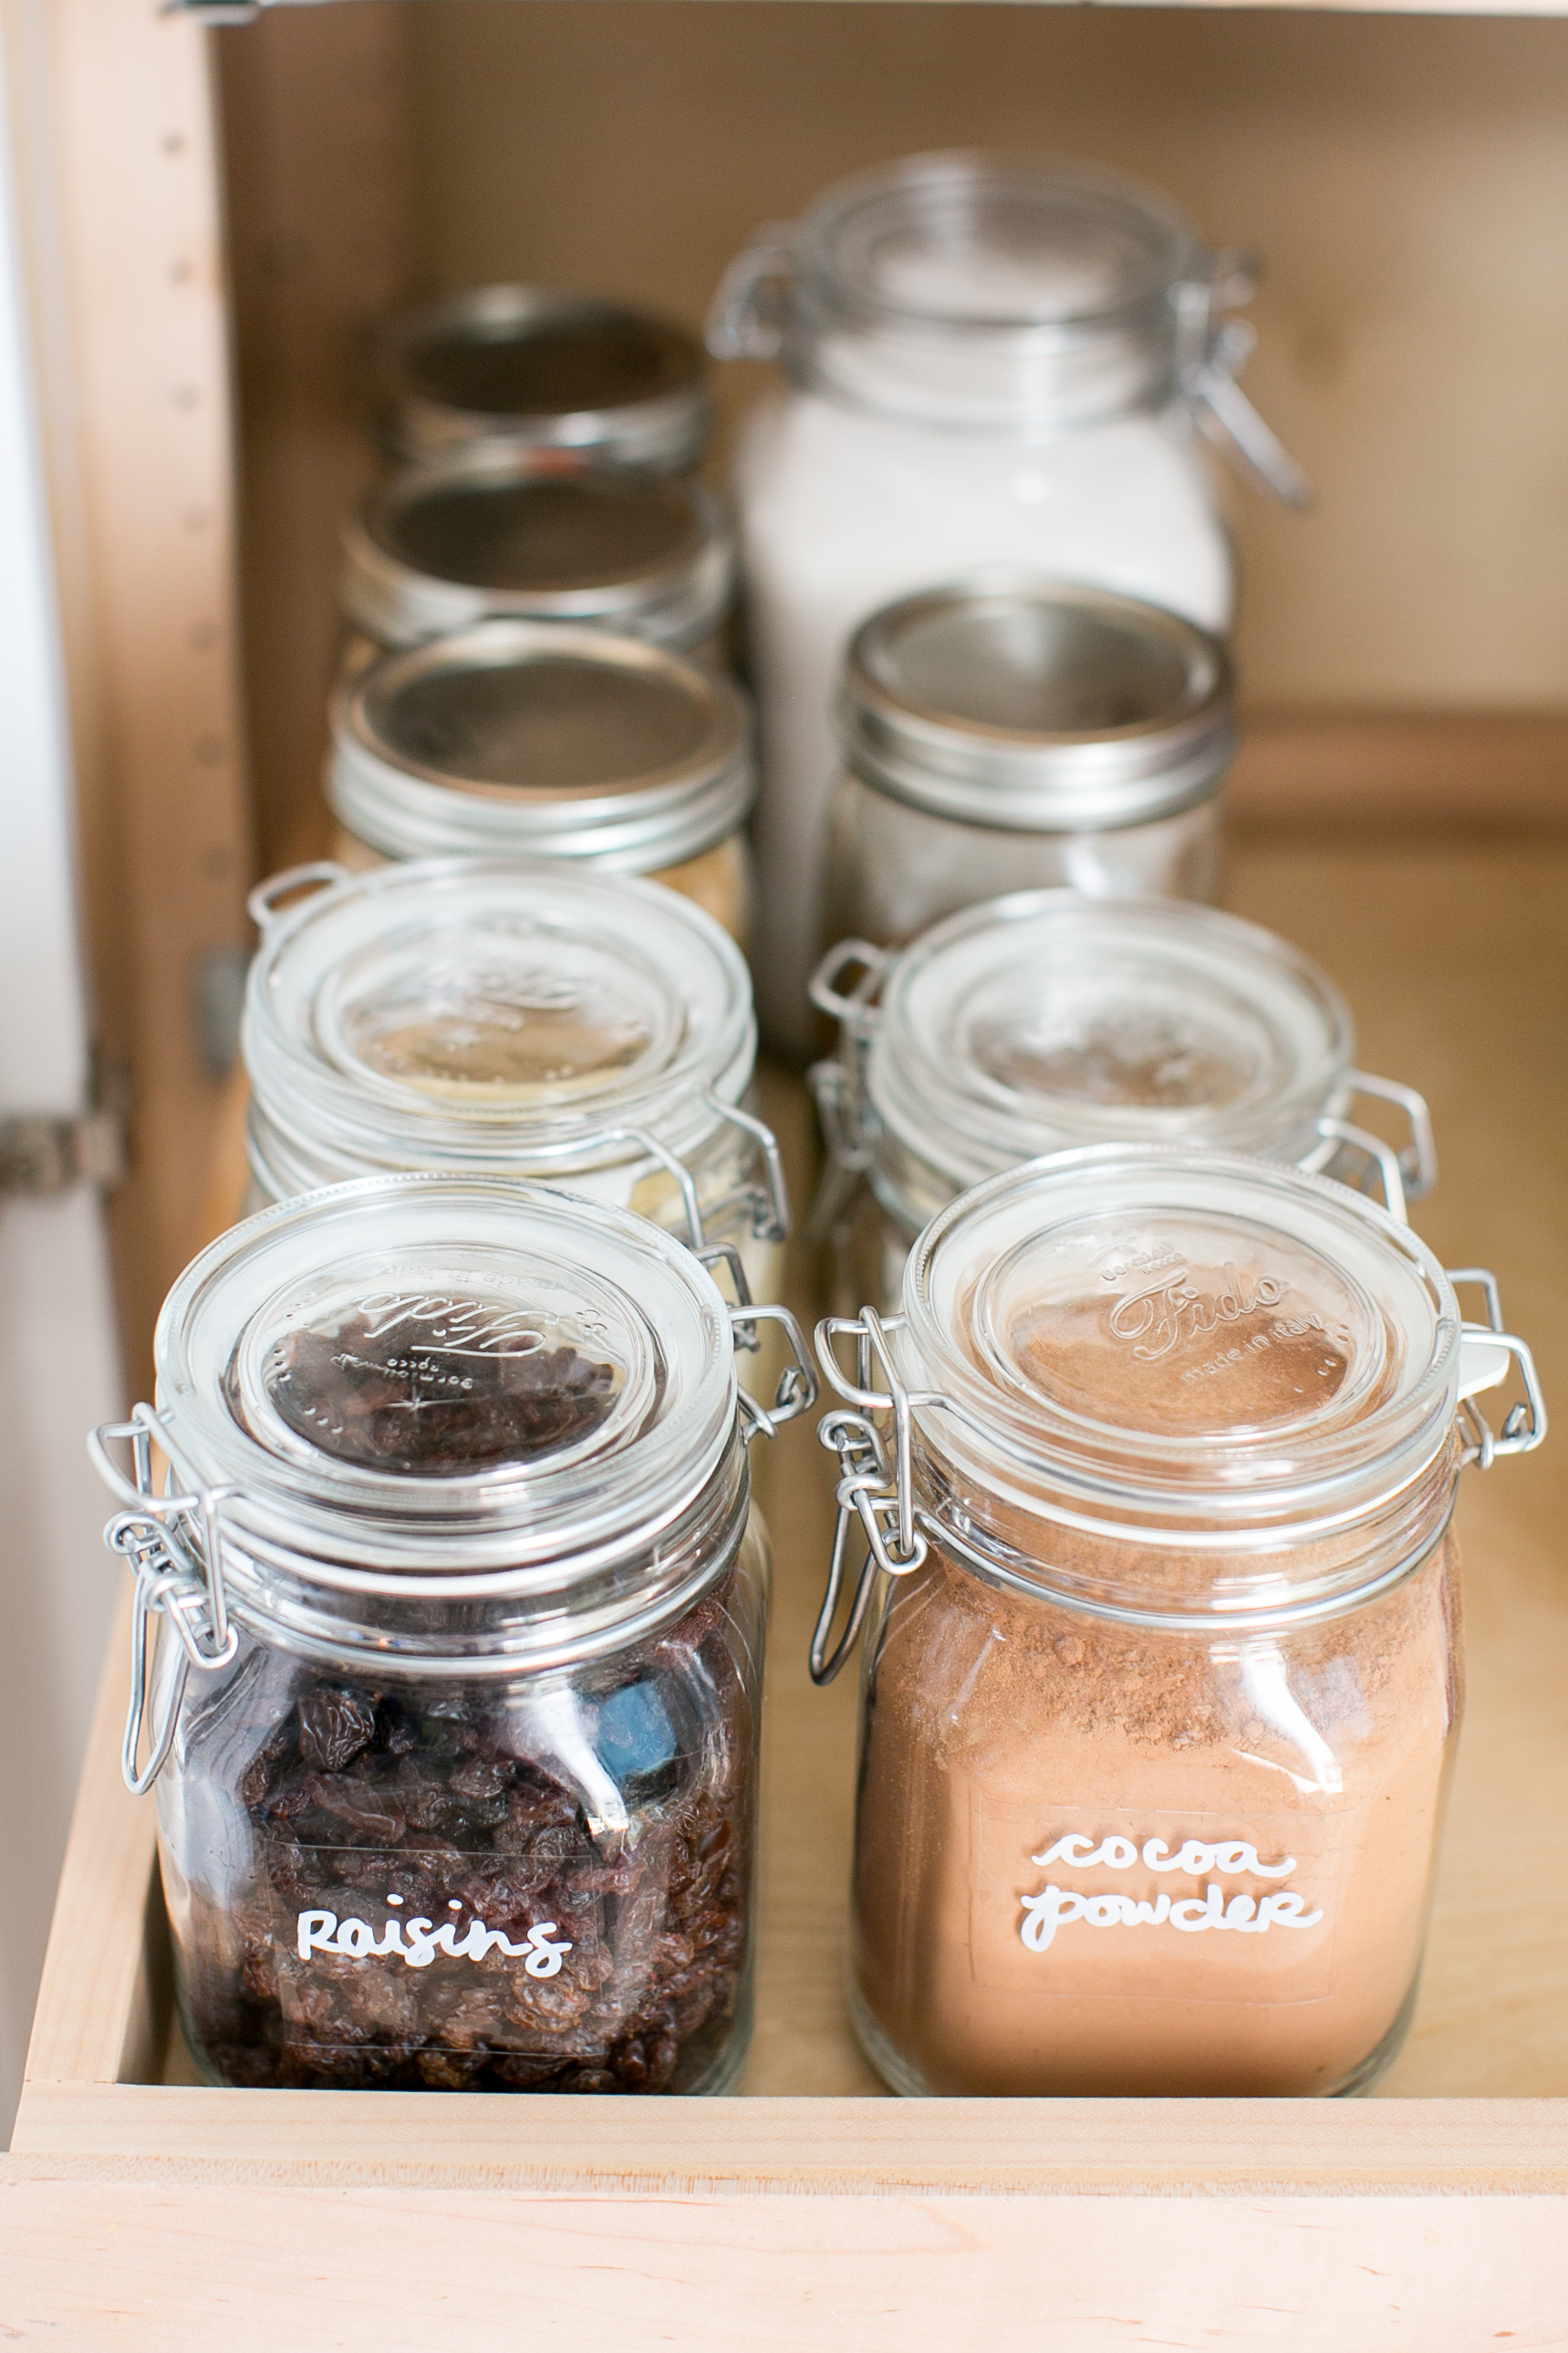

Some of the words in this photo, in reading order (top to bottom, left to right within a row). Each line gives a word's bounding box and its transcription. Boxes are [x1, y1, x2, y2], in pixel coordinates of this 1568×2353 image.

[352, 1292, 560, 1358] Fido
[1110, 1262, 1289, 1360] Fido
[1181, 1348, 1244, 1384] made
[1243, 1335, 1271, 1353] in
[1031, 1833, 1297, 1878] cocoa
[297, 1893, 573, 1978] Raisins
[1020, 1883, 1324, 1952] powder
